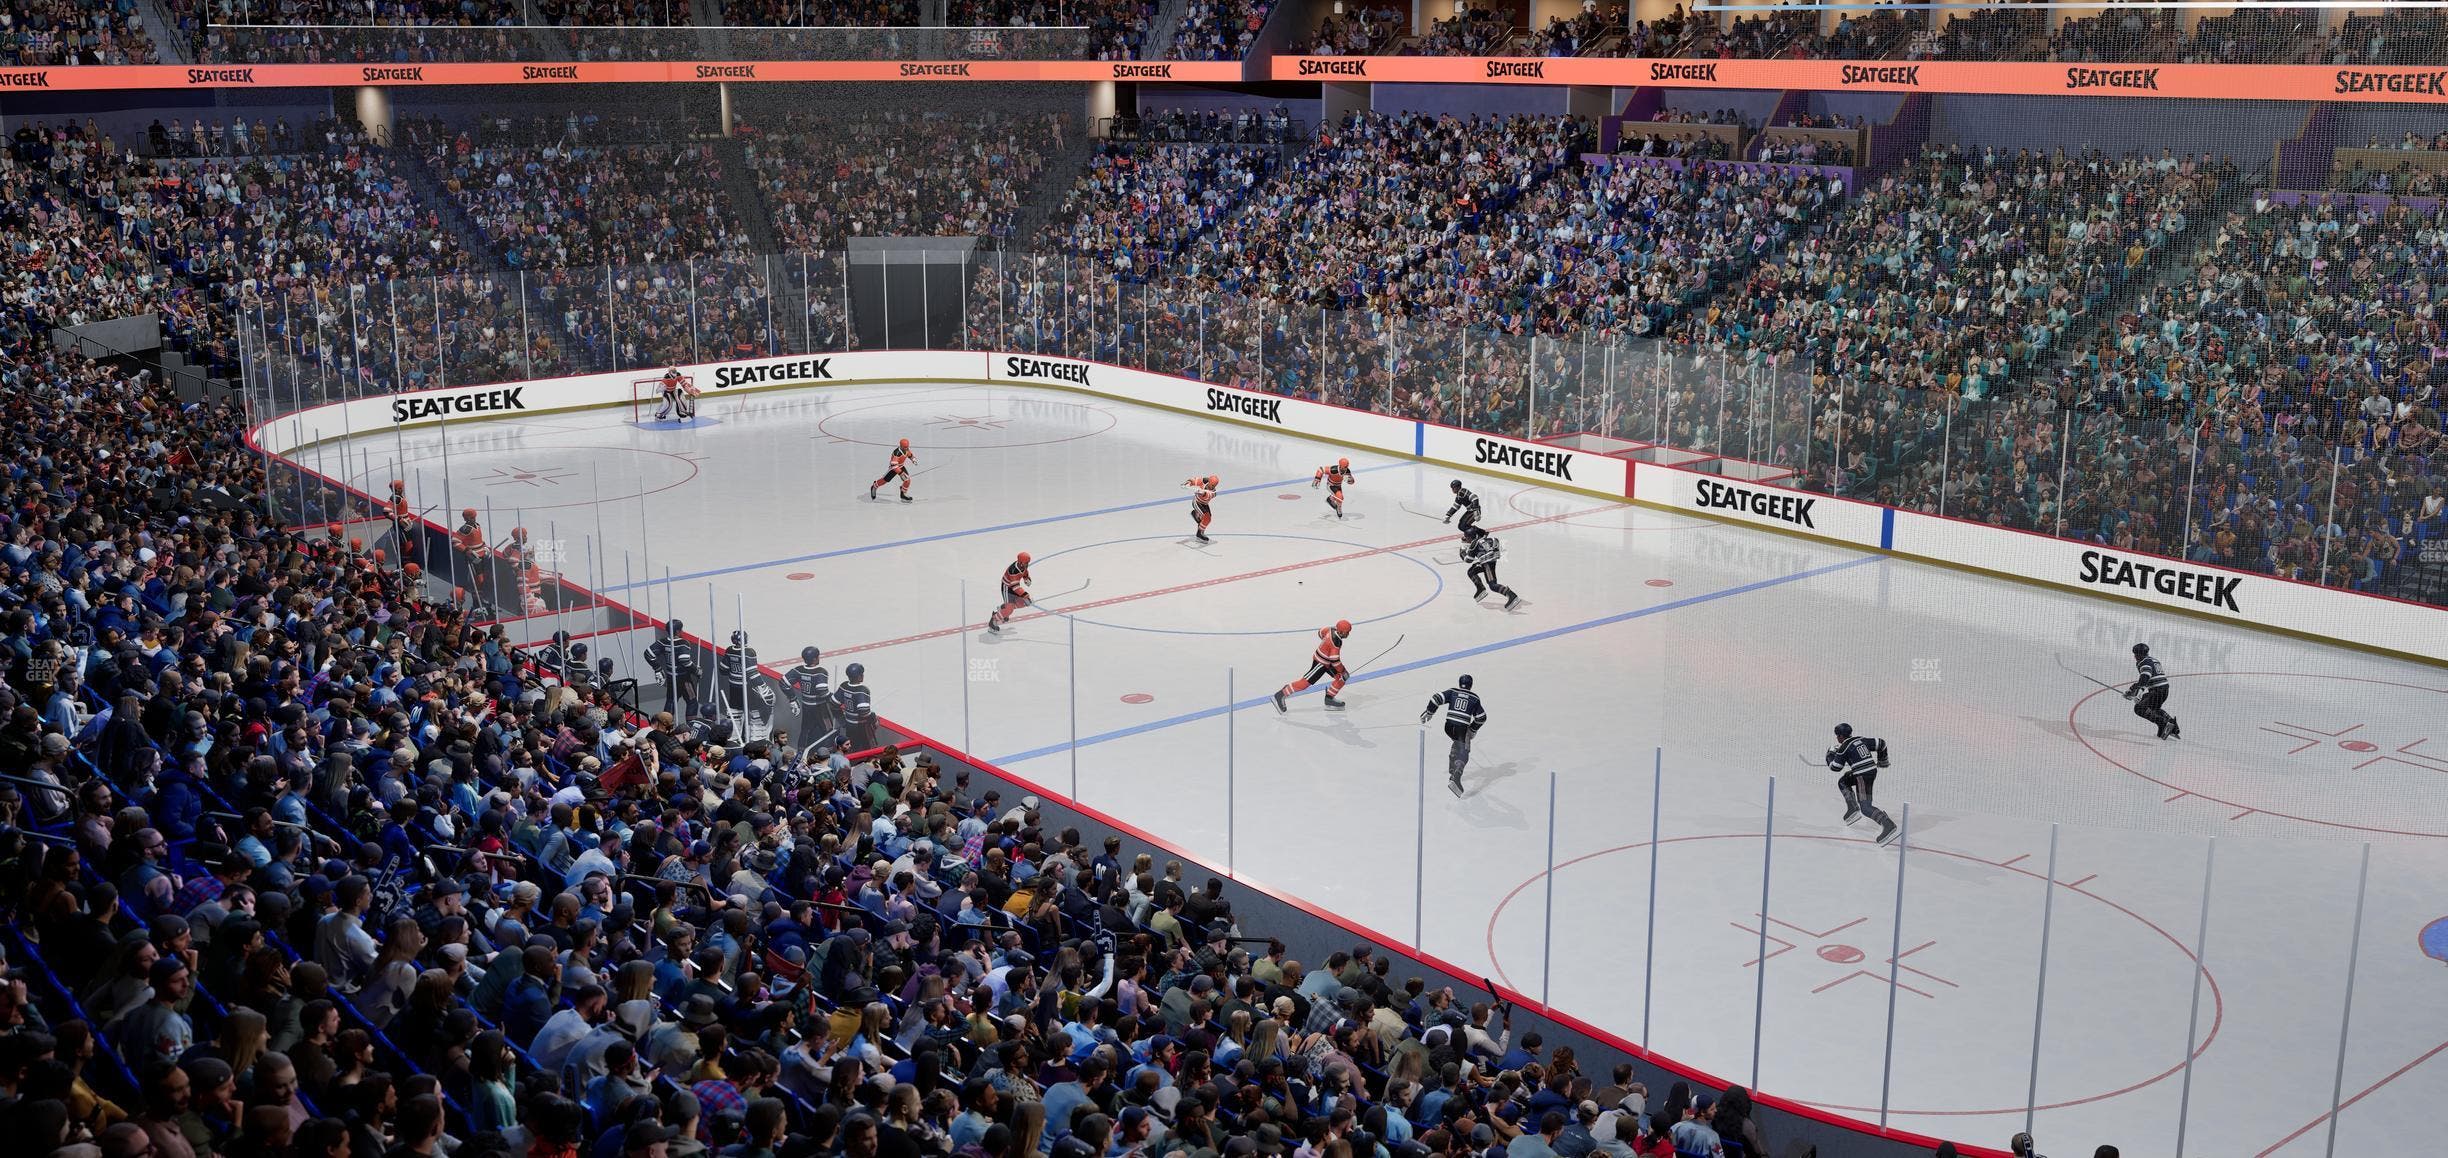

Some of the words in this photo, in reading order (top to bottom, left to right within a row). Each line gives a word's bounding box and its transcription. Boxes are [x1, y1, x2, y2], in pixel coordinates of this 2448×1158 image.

[188, 68, 254, 84] SEATGEEK
[363, 66, 423, 81] SEATGEEK
[522, 65, 578, 80] SEATGEEK
[696, 64, 755, 79] SEATGEEK
[900, 63, 969, 77] SEATGEEK
[1113, 64, 1171, 78] SEATGEEK
[1299, 60, 1367, 77] SEATGEEK
[1486, 61, 1544, 79] SEATGEEK
[1651, 63, 1717, 82] SEATGEEK
[1841, 64, 1920, 86] SEATGEEK
[0, 71, 49, 87] ATGEEK
[2066, 67, 2160, 91] SEATGEEK
[2335, 70, 2447, 96] SEATGEEK
[715, 357, 833, 389] SEATGEEK
[1007, 356, 1090, 387] SEATGEEK
[392, 387, 526, 423] SEATGEEK
[1207, 387, 1282, 424] SEATGEEK
[1475, 437, 1573, 482] SEATGEEK
[1696, 478, 1816, 529] SEATGEEK
[2079, 550, 2243, 614] SEATGEEK
